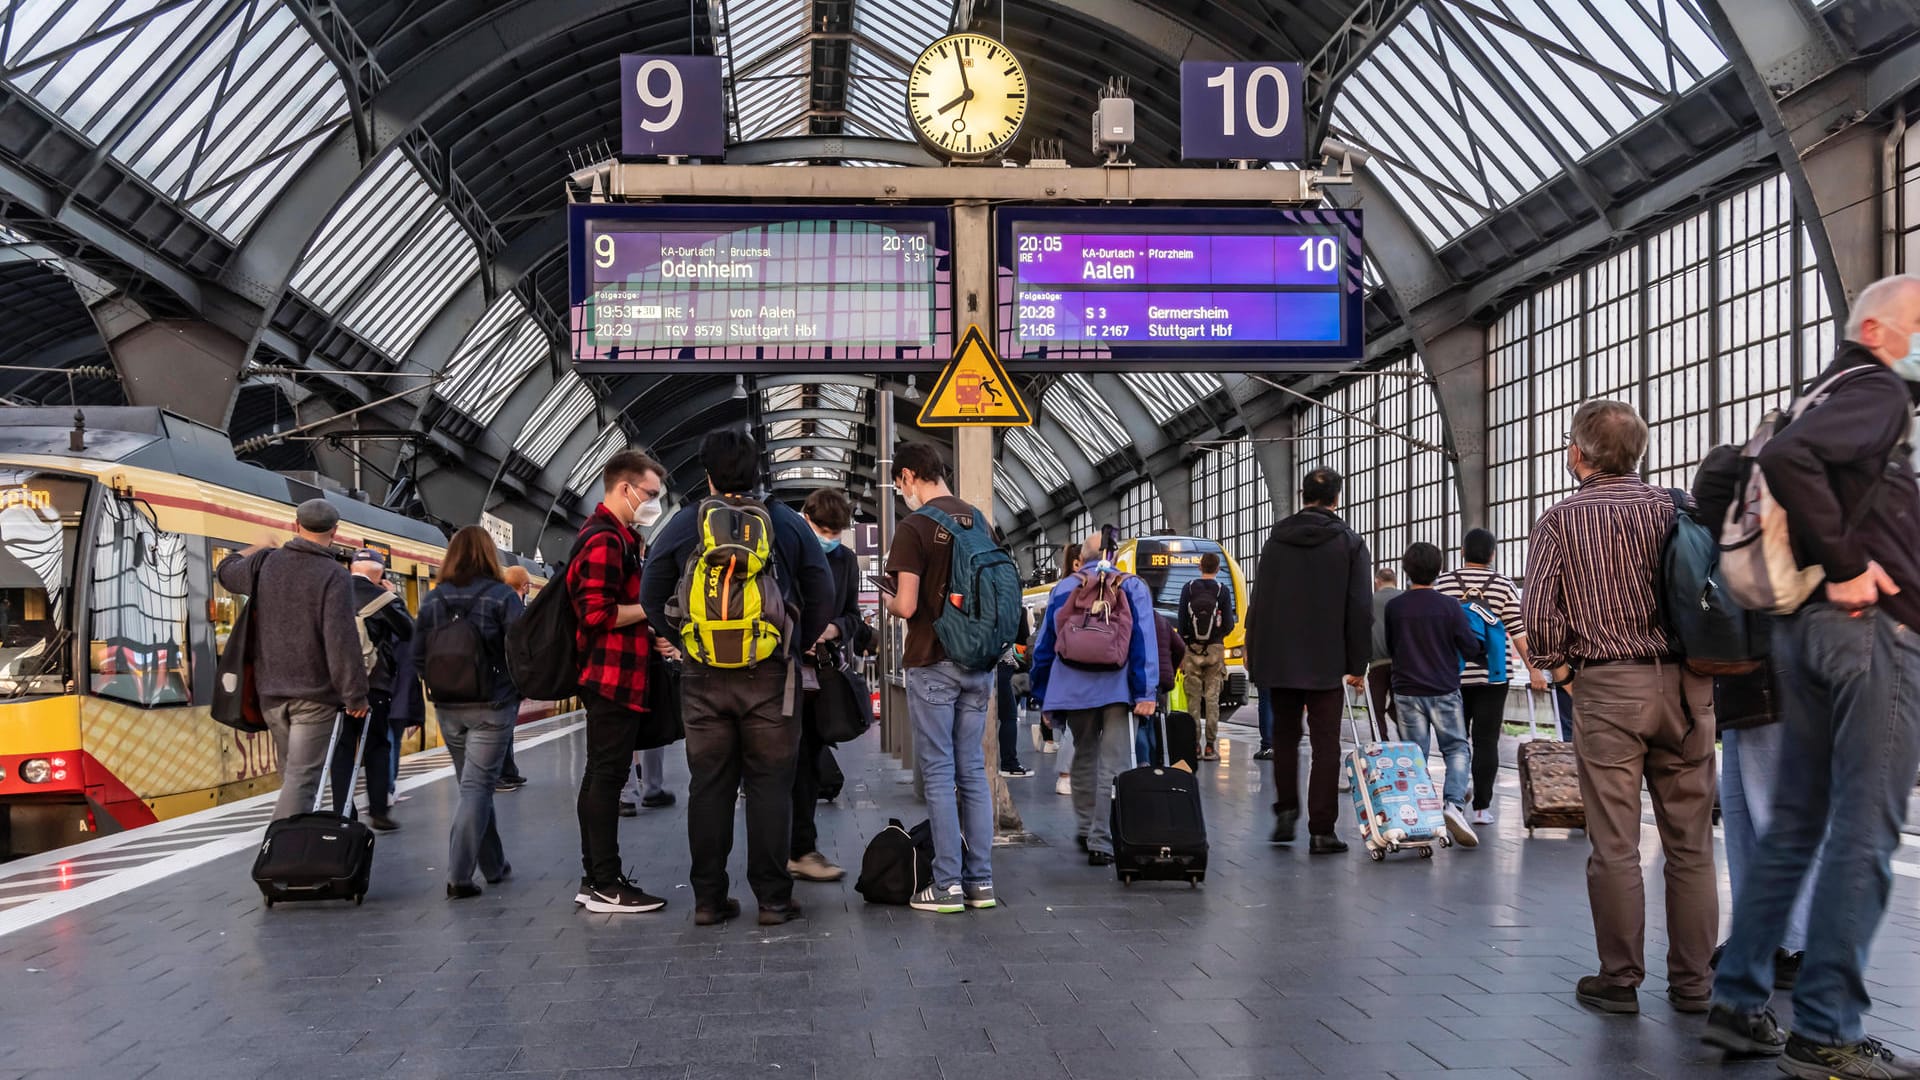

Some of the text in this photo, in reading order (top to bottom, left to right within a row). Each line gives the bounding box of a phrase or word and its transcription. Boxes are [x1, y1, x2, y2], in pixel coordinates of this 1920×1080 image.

[636, 59, 684, 133] 9
[1206, 65, 1290, 137] 10
[882, 236, 925, 251] 20:10
[1019, 236, 1062, 251] 20:05
[594, 234, 615, 269] 9
[661, 246, 771, 257] KA-Durlach Bruchsal
[904, 253, 925, 262] S 31
[1019, 253, 1043, 263] IRE 1
[1082, 248, 1193, 259] KA-Durlach Pforzheim
[1299, 237, 1337, 272] 10
[661, 260, 752, 278] Odenheim
[1082, 260, 1134, 279] Aalen
[594, 291, 639, 300] Folgezüge:
[1019, 292, 1063, 302] Folgezüge:
[596, 305, 631, 318] 19:53
[664, 307, 682, 318] IRE
[688, 307, 695, 318] 1
[729, 308, 753, 318] von
[759, 306, 796, 318] Aalen
[1019, 305, 1229, 320] 20:28 S 3 Germersheim
[594, 323, 817, 340] 20:29 TGV 9579 Stuttgart Hbf
[1019, 324, 1233, 340] 21:06 IC 2167 Stuttgart Hbf
